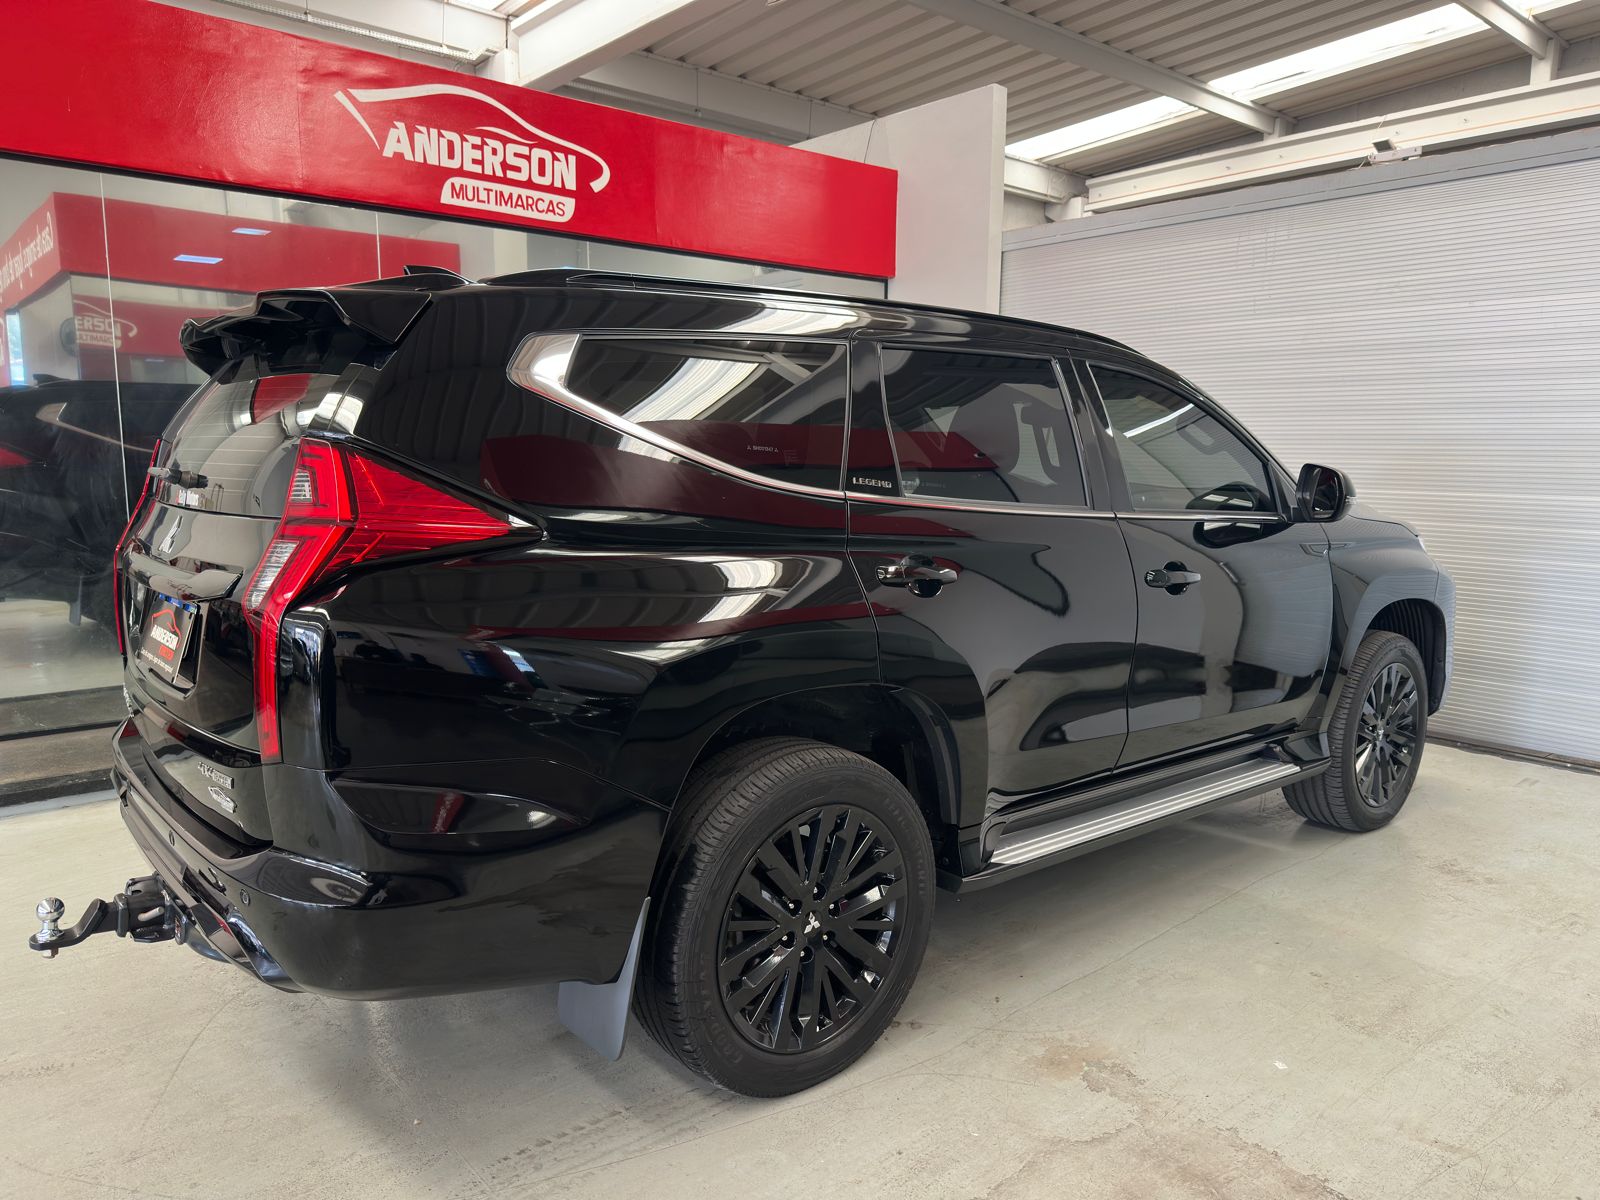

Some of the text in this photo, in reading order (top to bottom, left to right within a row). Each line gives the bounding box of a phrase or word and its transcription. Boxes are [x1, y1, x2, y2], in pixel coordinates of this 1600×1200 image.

[382, 121, 577, 191] ANDERSON
[451, 182, 565, 217] MULTIMARCAS
[852, 477, 892, 489] LEGEND
